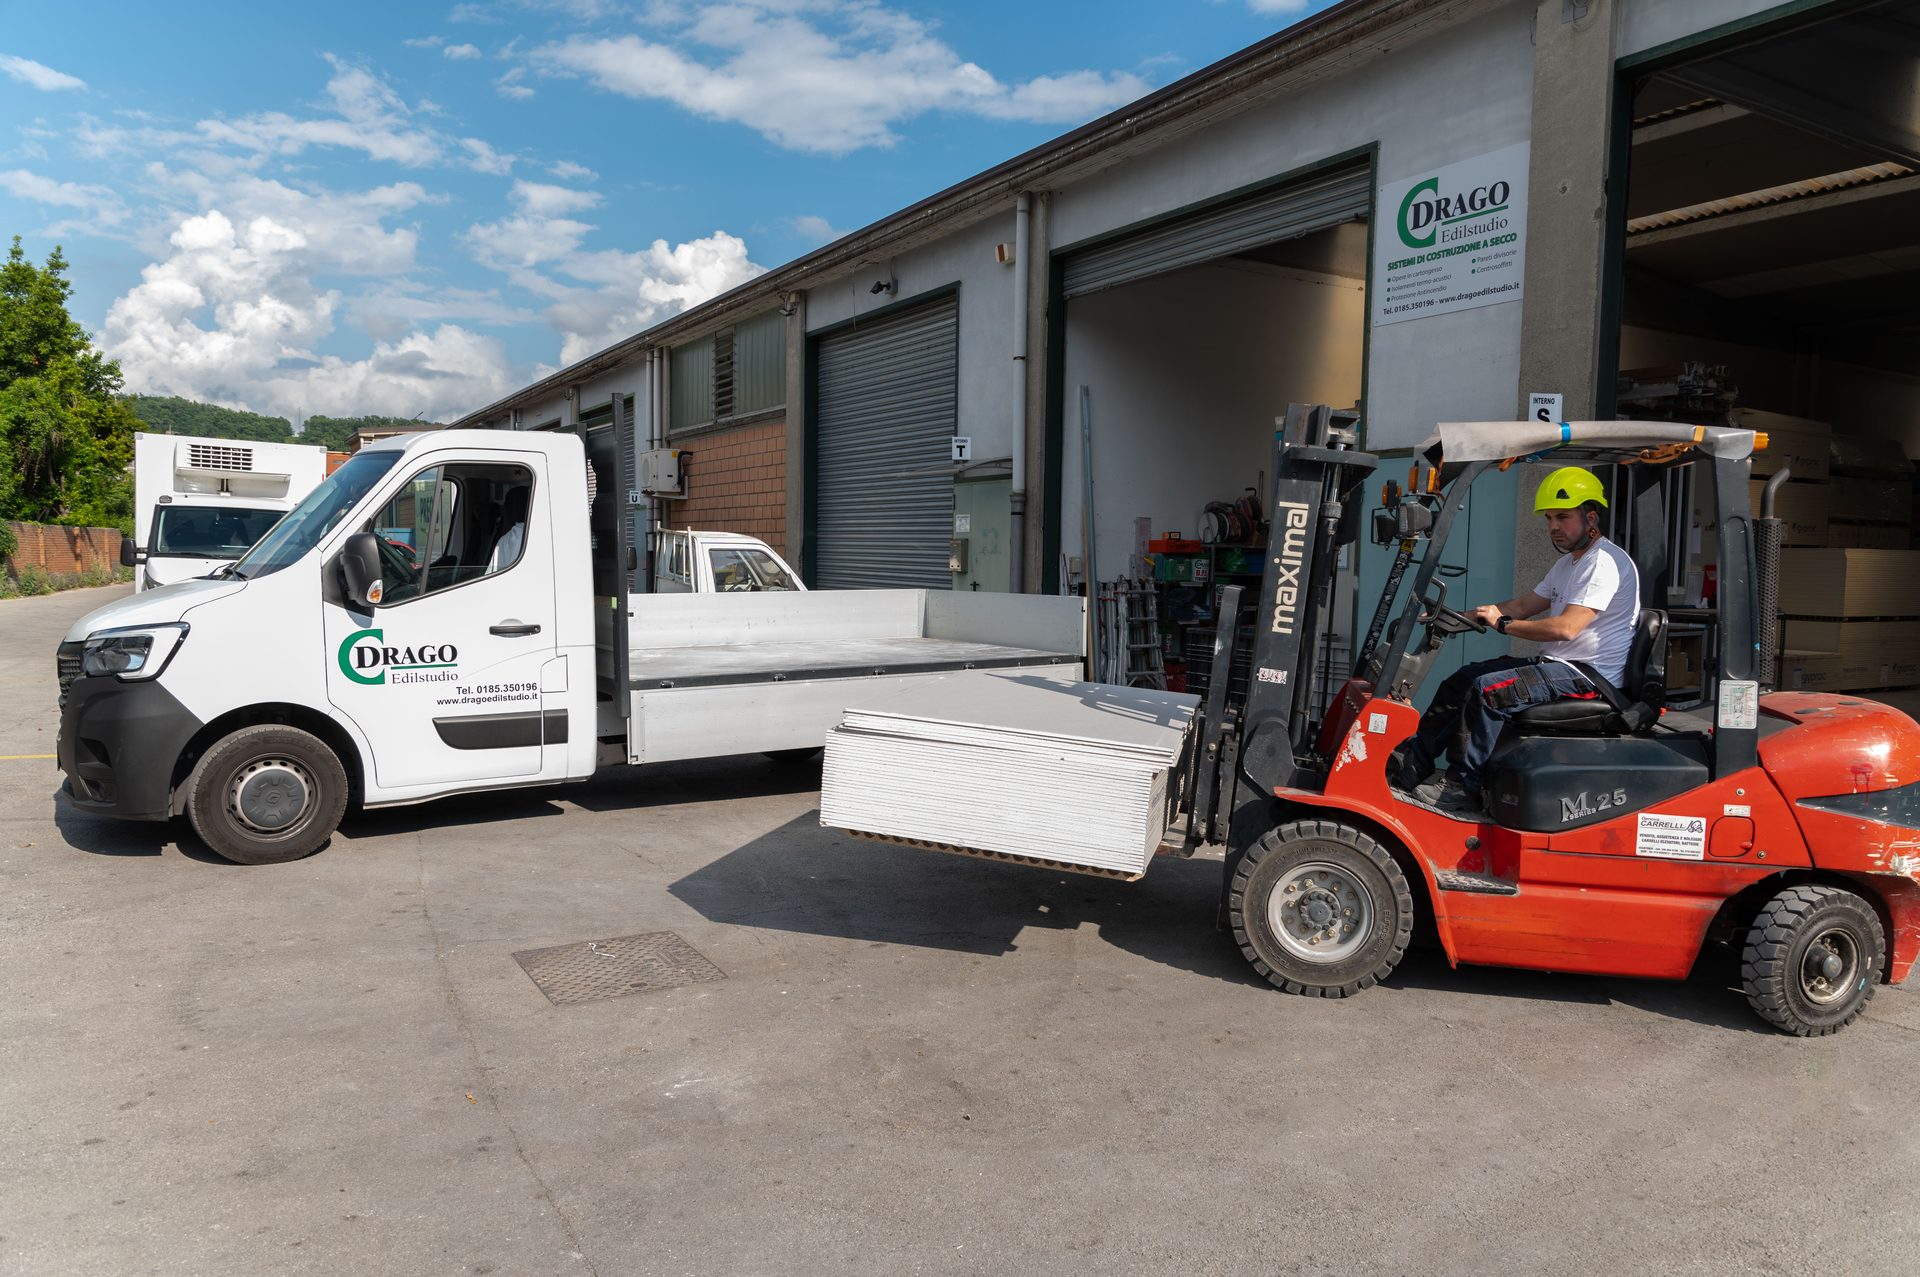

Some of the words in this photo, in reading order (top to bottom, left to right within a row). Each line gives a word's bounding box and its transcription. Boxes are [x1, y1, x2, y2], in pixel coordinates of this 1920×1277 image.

[1410, 181, 1510, 231] DRAGO
[1441, 216, 1508, 244] Edilstudio
[1387, 256, 1416, 271] SISTEMI
[1416, 254, 1426, 265] DI
[1426, 240, 1482, 262] COSTRUZIONE
[1482, 239, 1489, 249] A
[1489, 232, 1518, 247] SECCO
[1493, 249, 1517, 259] divisorie
[1476, 260, 1513, 274] Controsoffitti
[1383, 307, 1394, 315] Tel.
[1394, 299, 1435, 313] 0185.350196
[1438, 282, 1520, 304] www.dragoedilstudio.it
[1532, 397, 1556, 405] INTERNO
[956, 444, 966, 458] T
[631, 495, 638, 503] U
[1271, 501, 1310, 635] maximal
[353, 644, 458, 669] DRAGO
[392, 670, 459, 685] Edilstudio
[456, 685, 474, 695] Tel.
[476, 682, 538, 695] 0185.350196
[436, 692, 538, 705] www.dragoedilstudio.it
[1596, 788, 1627, 811] 25
[1569, 807, 1597, 820] SERIES
[1640, 820, 1684, 829] CARRELLI
